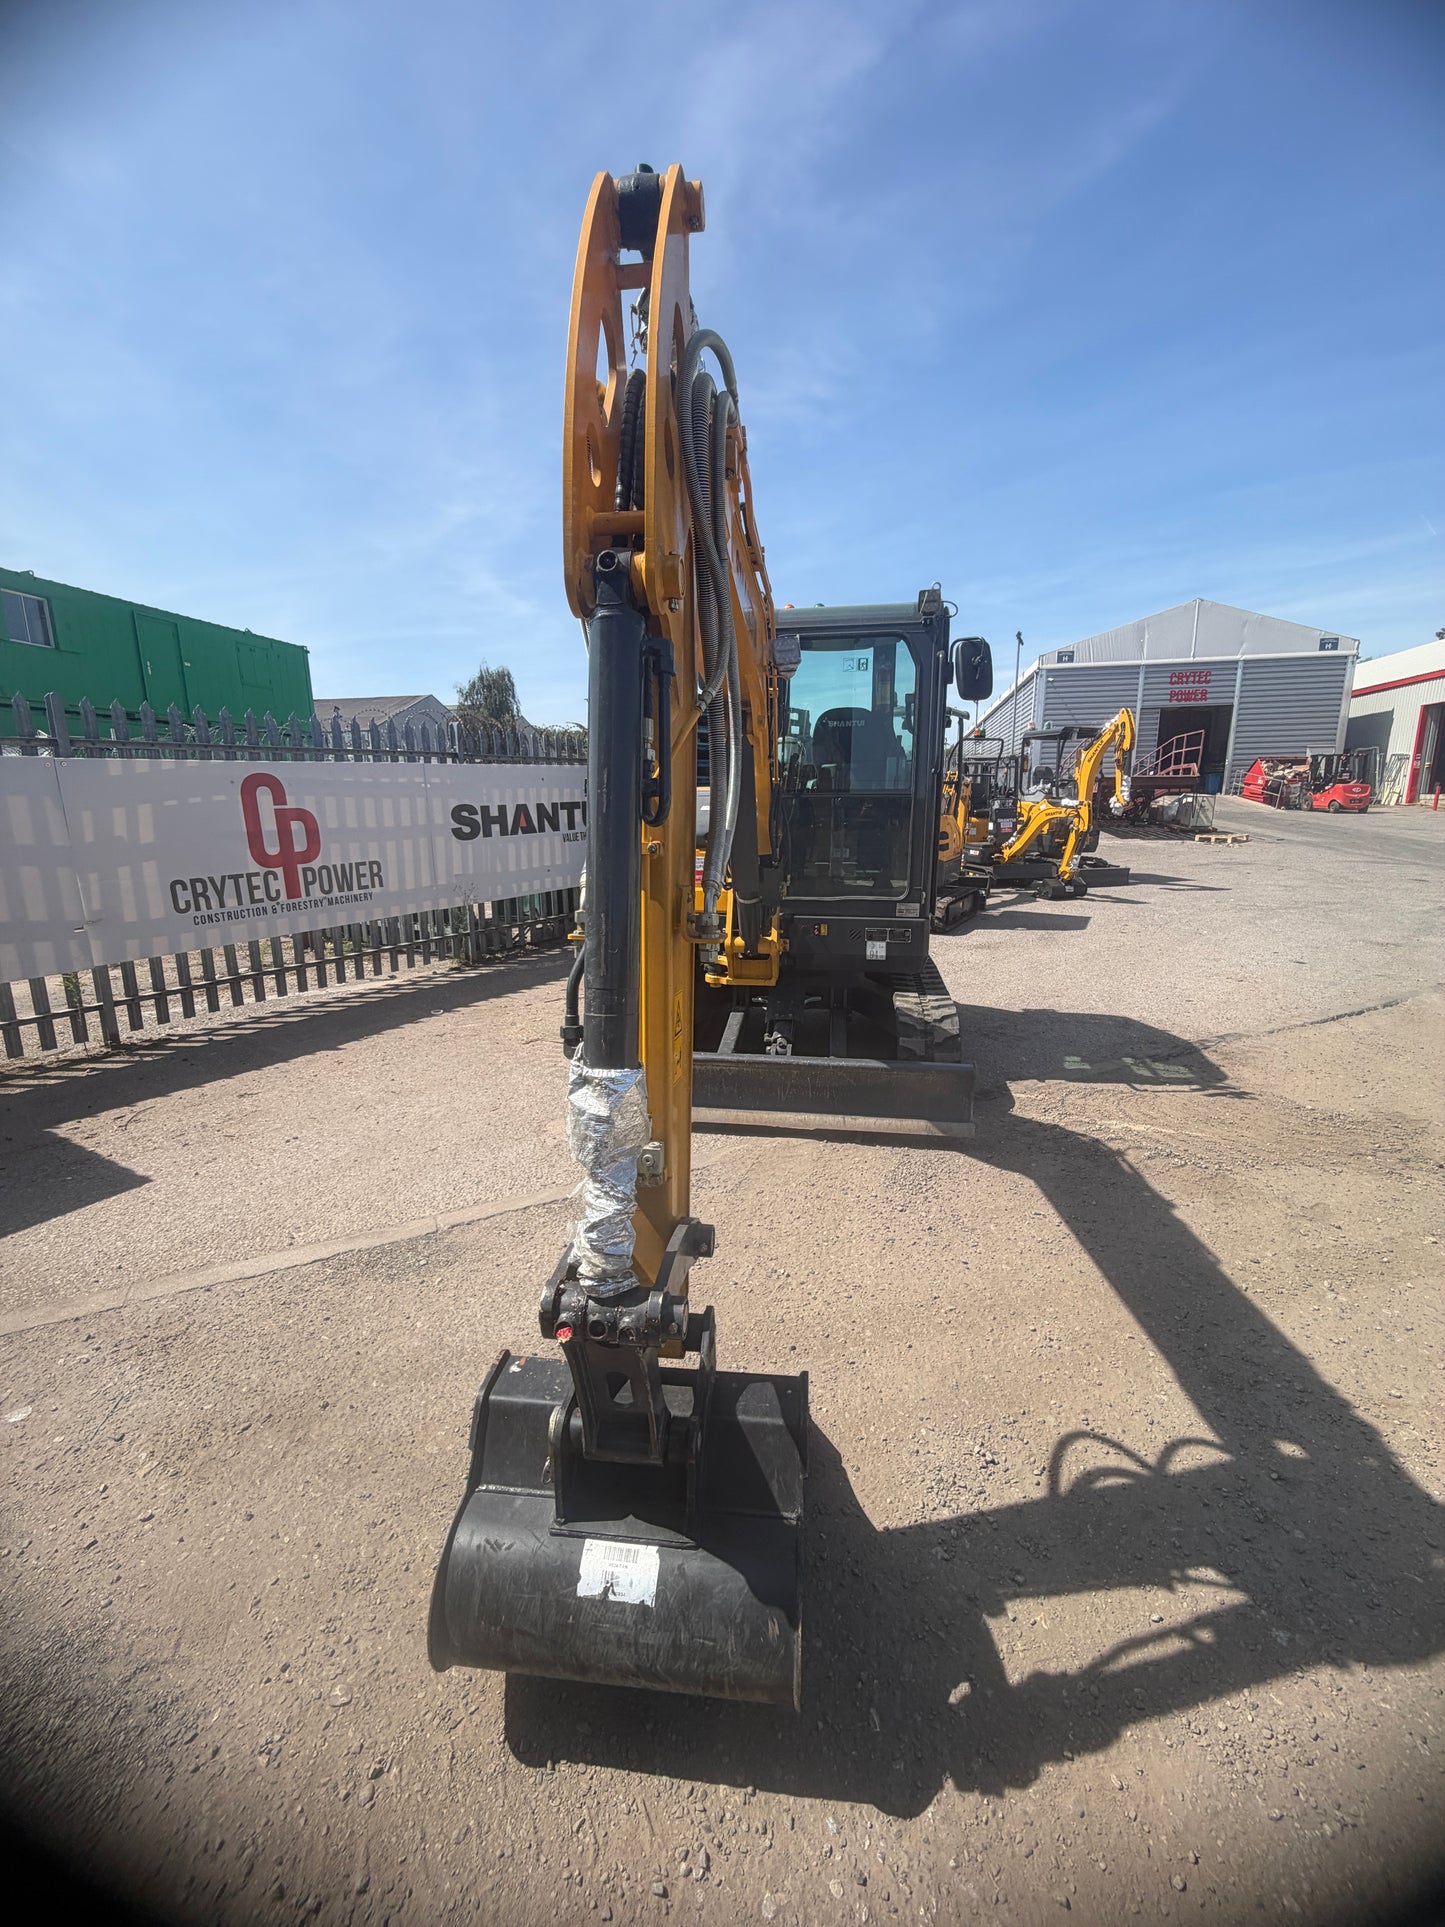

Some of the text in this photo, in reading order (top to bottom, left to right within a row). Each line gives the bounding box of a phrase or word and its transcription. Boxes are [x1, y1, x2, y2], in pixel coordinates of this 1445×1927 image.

[1169, 671, 1212, 685] CRYTEC
[1168, 689, 1208, 703] POWER
[450, 801, 587, 841] SHANT
[561, 831, 580, 843] VALUE
[169, 860, 385, 914] CRYTEC POWER
[193, 891, 374, 926] CONSTRUCTION & FORESTRY MACHINERY
